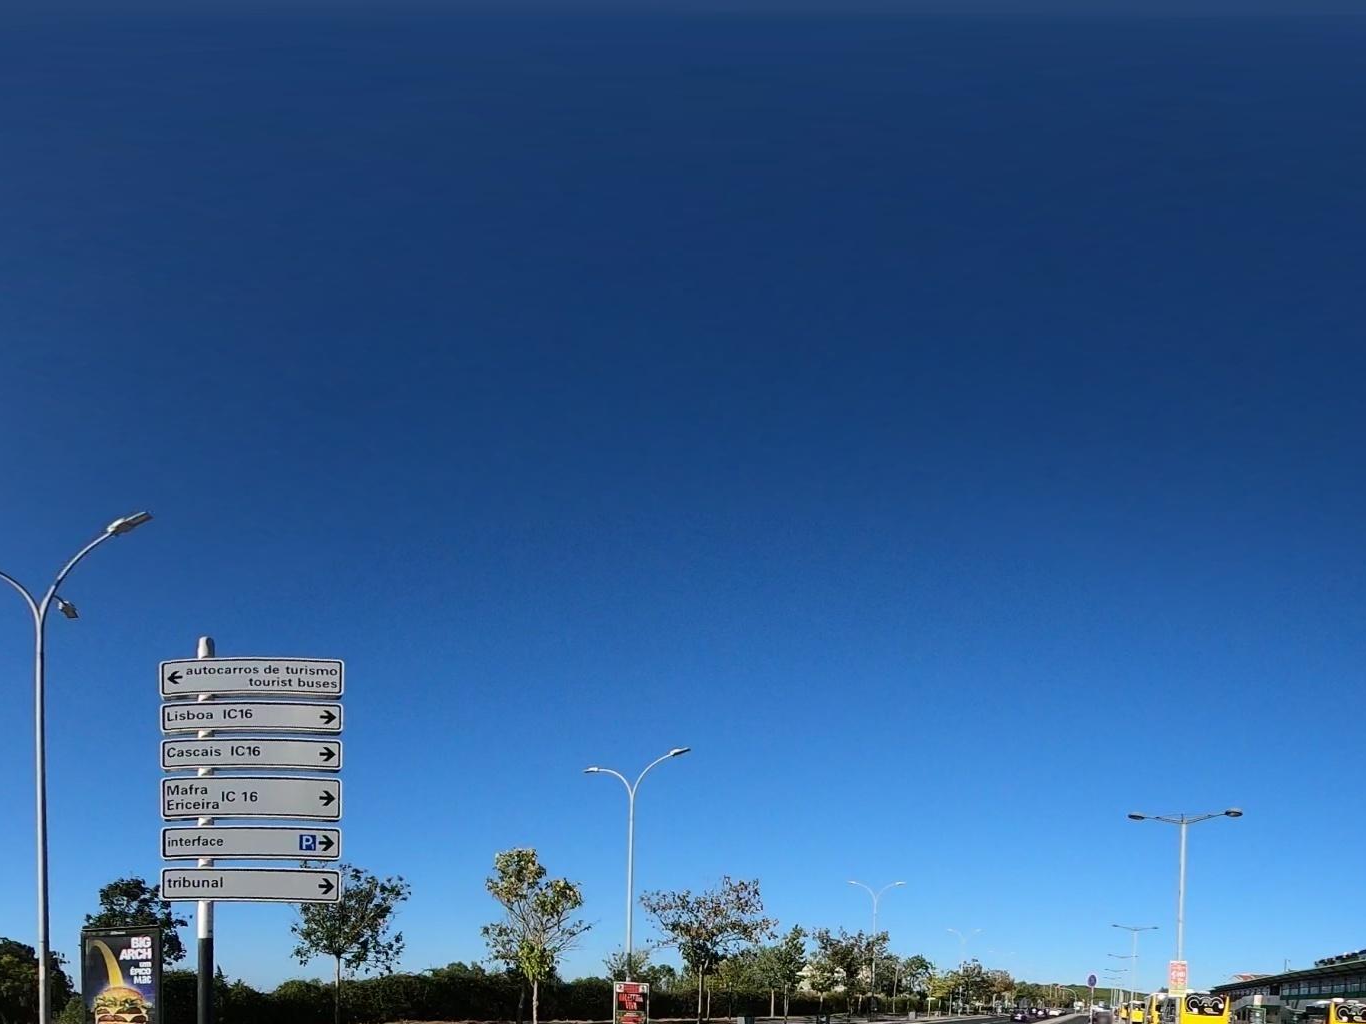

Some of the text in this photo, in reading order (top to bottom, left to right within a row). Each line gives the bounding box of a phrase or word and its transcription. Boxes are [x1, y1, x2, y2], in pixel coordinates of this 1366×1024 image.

[186, 664, 338, 676] autocarros de turismo
[249, 677, 338, 689] tourist buses
[167, 709, 253, 721] Lisboa IC16
[167, 746, 261, 758] Cascais IC16
[167, 784, 208, 796] Mafra
[221, 791, 258, 802] IC 16
[167, 799, 220, 811] Ericeira
[167, 836, 224, 848] interface
[167, 877, 224, 889] tribunal
[131, 937, 151, 948] BIG
[119, 949, 152, 960] ARCH
